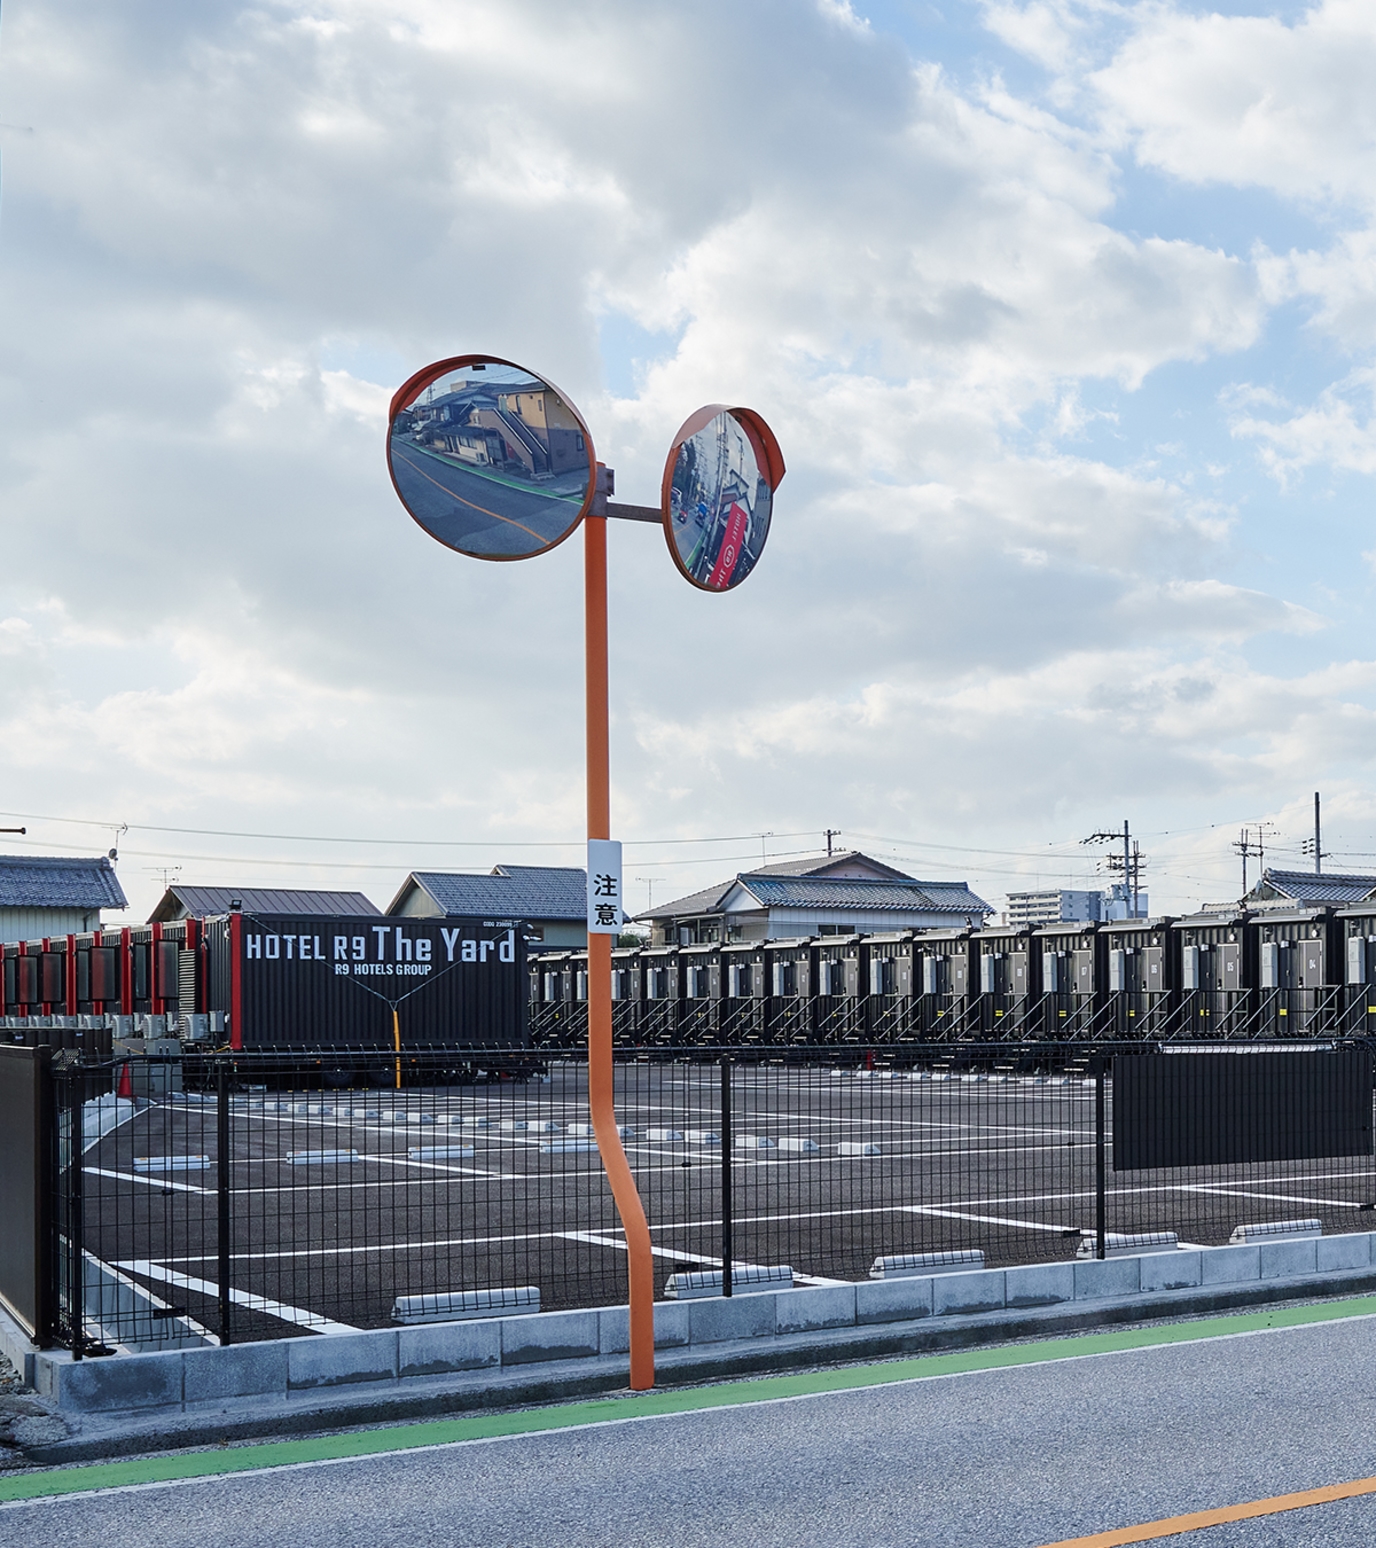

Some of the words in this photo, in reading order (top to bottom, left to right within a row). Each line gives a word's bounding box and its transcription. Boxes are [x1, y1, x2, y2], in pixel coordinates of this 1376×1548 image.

[594, 873, 618, 926] 注意
[246, 934, 326, 960] HOTEL
[334, 935, 366, 960] R9
[372, 926, 432, 961] The
[440, 928, 515, 962] Yard
[335, 963, 350, 975] R9
[354, 963, 393, 975] HOTELS
[396, 963, 432, 975] GROUP
